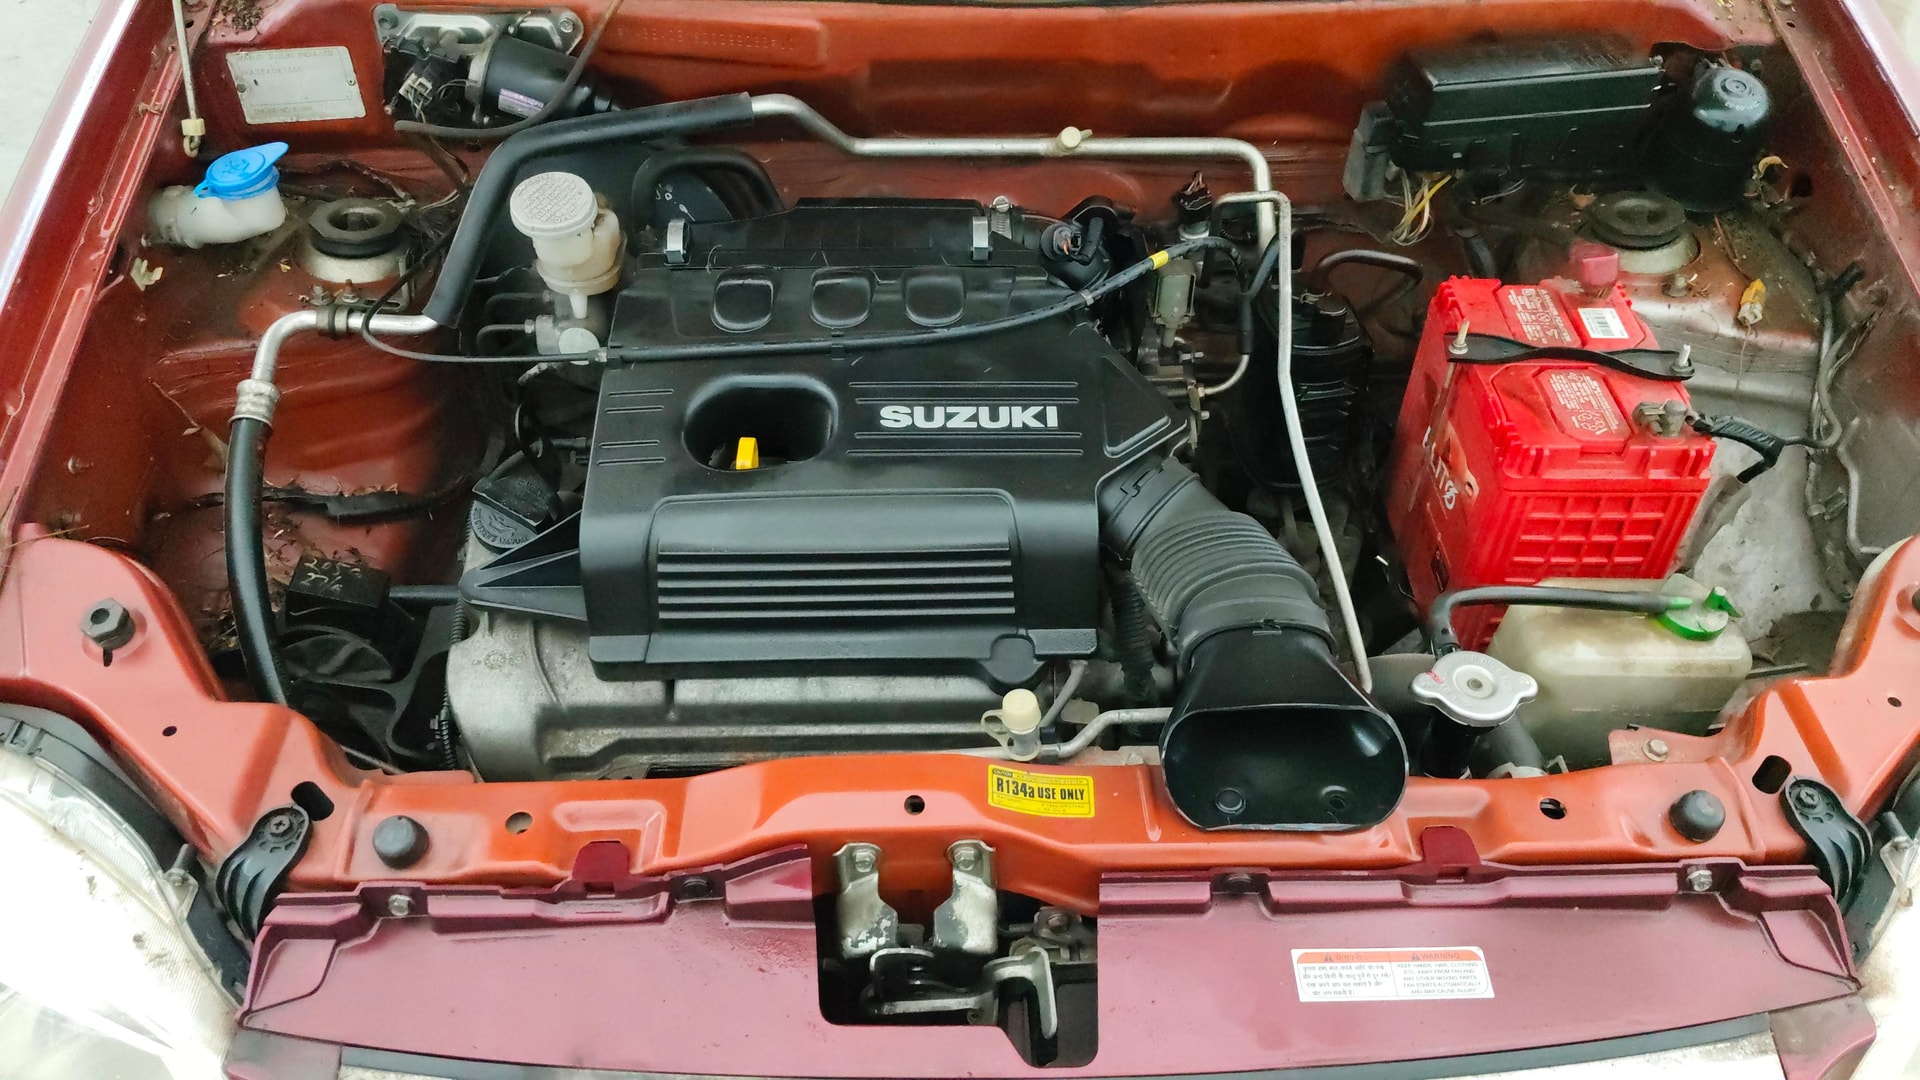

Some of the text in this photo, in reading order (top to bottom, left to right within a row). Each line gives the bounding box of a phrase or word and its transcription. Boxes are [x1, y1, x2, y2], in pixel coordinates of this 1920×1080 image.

[880, 405, 1058, 428] SUZUKI
[997, 777, 1084, 800] R134a USE ONLY
